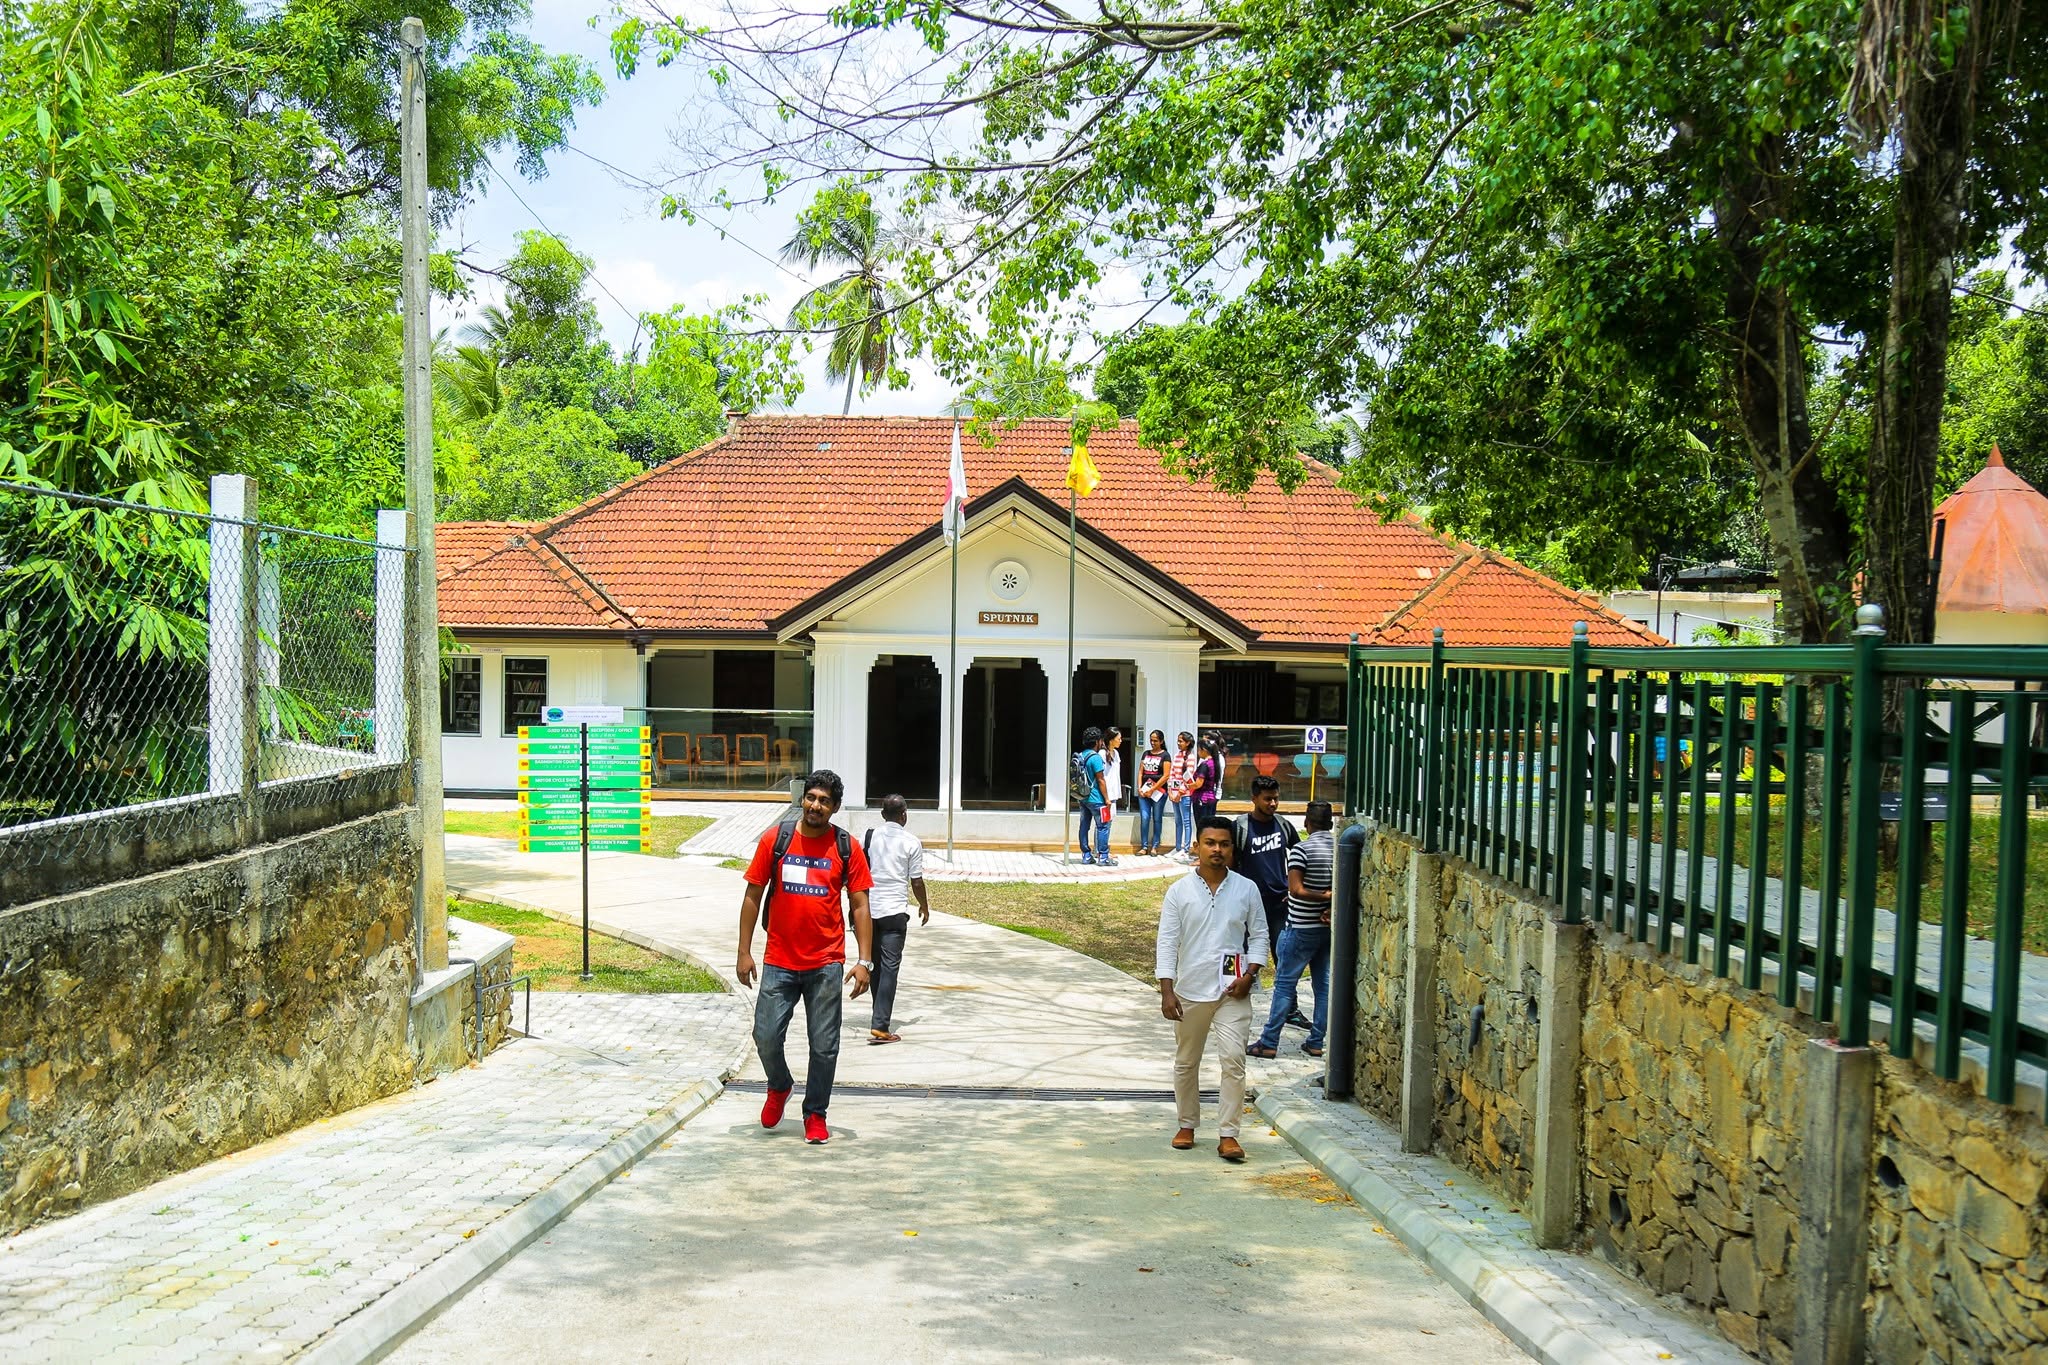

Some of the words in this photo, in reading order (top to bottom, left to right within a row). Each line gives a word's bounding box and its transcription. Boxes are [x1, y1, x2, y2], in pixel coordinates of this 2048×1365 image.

[983, 613, 1034, 623] SPUTNIK
[1251, 832, 1282, 854] NIKE
[787, 857, 828, 867] TOMMY
[785, 885, 824, 894] HILFIGER
